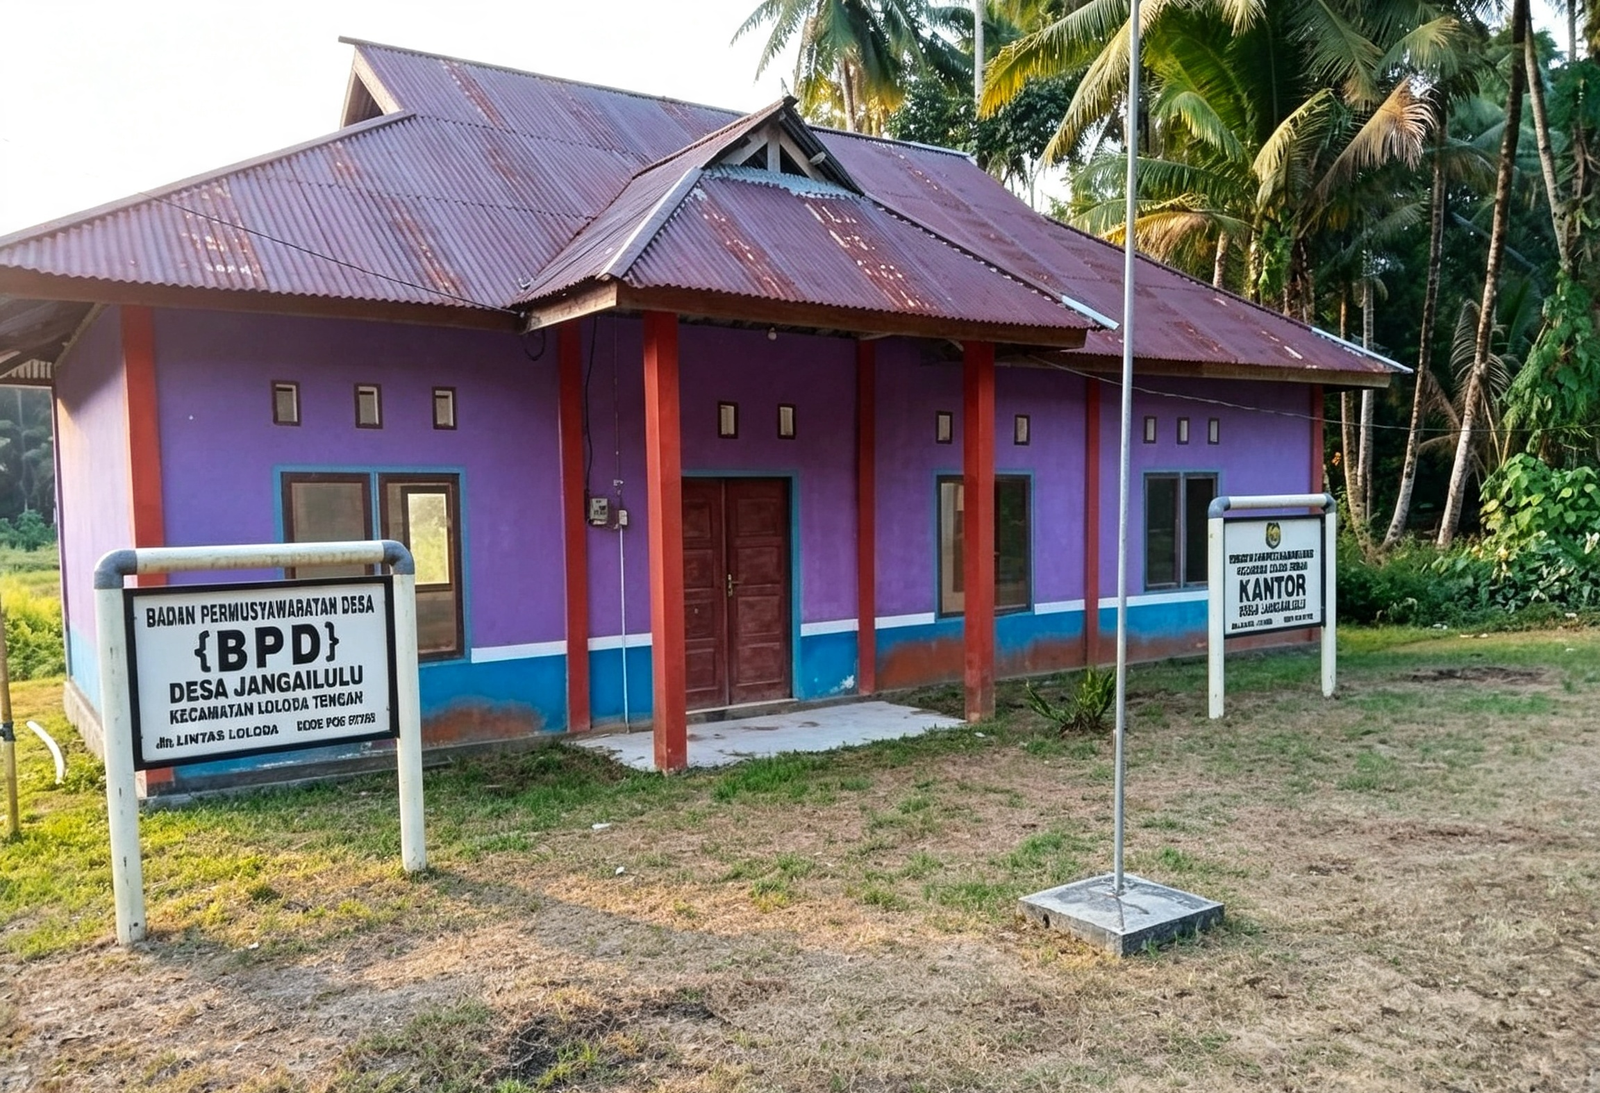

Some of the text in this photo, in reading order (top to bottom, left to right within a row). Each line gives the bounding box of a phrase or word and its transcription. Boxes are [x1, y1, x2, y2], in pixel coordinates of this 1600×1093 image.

[1239, 573, 1306, 603] KANTOR
[146, 605, 195, 628] BADAN
[342, 594, 375, 615] DESA
[169, 664, 363, 704] DESA JANGAILULU
[170, 703, 254, 725] KECAMATAN
[257, 696, 309, 715] LOLODA
[176, 730, 225, 747] LINTAS
[228, 724, 279, 740] LOLODA
